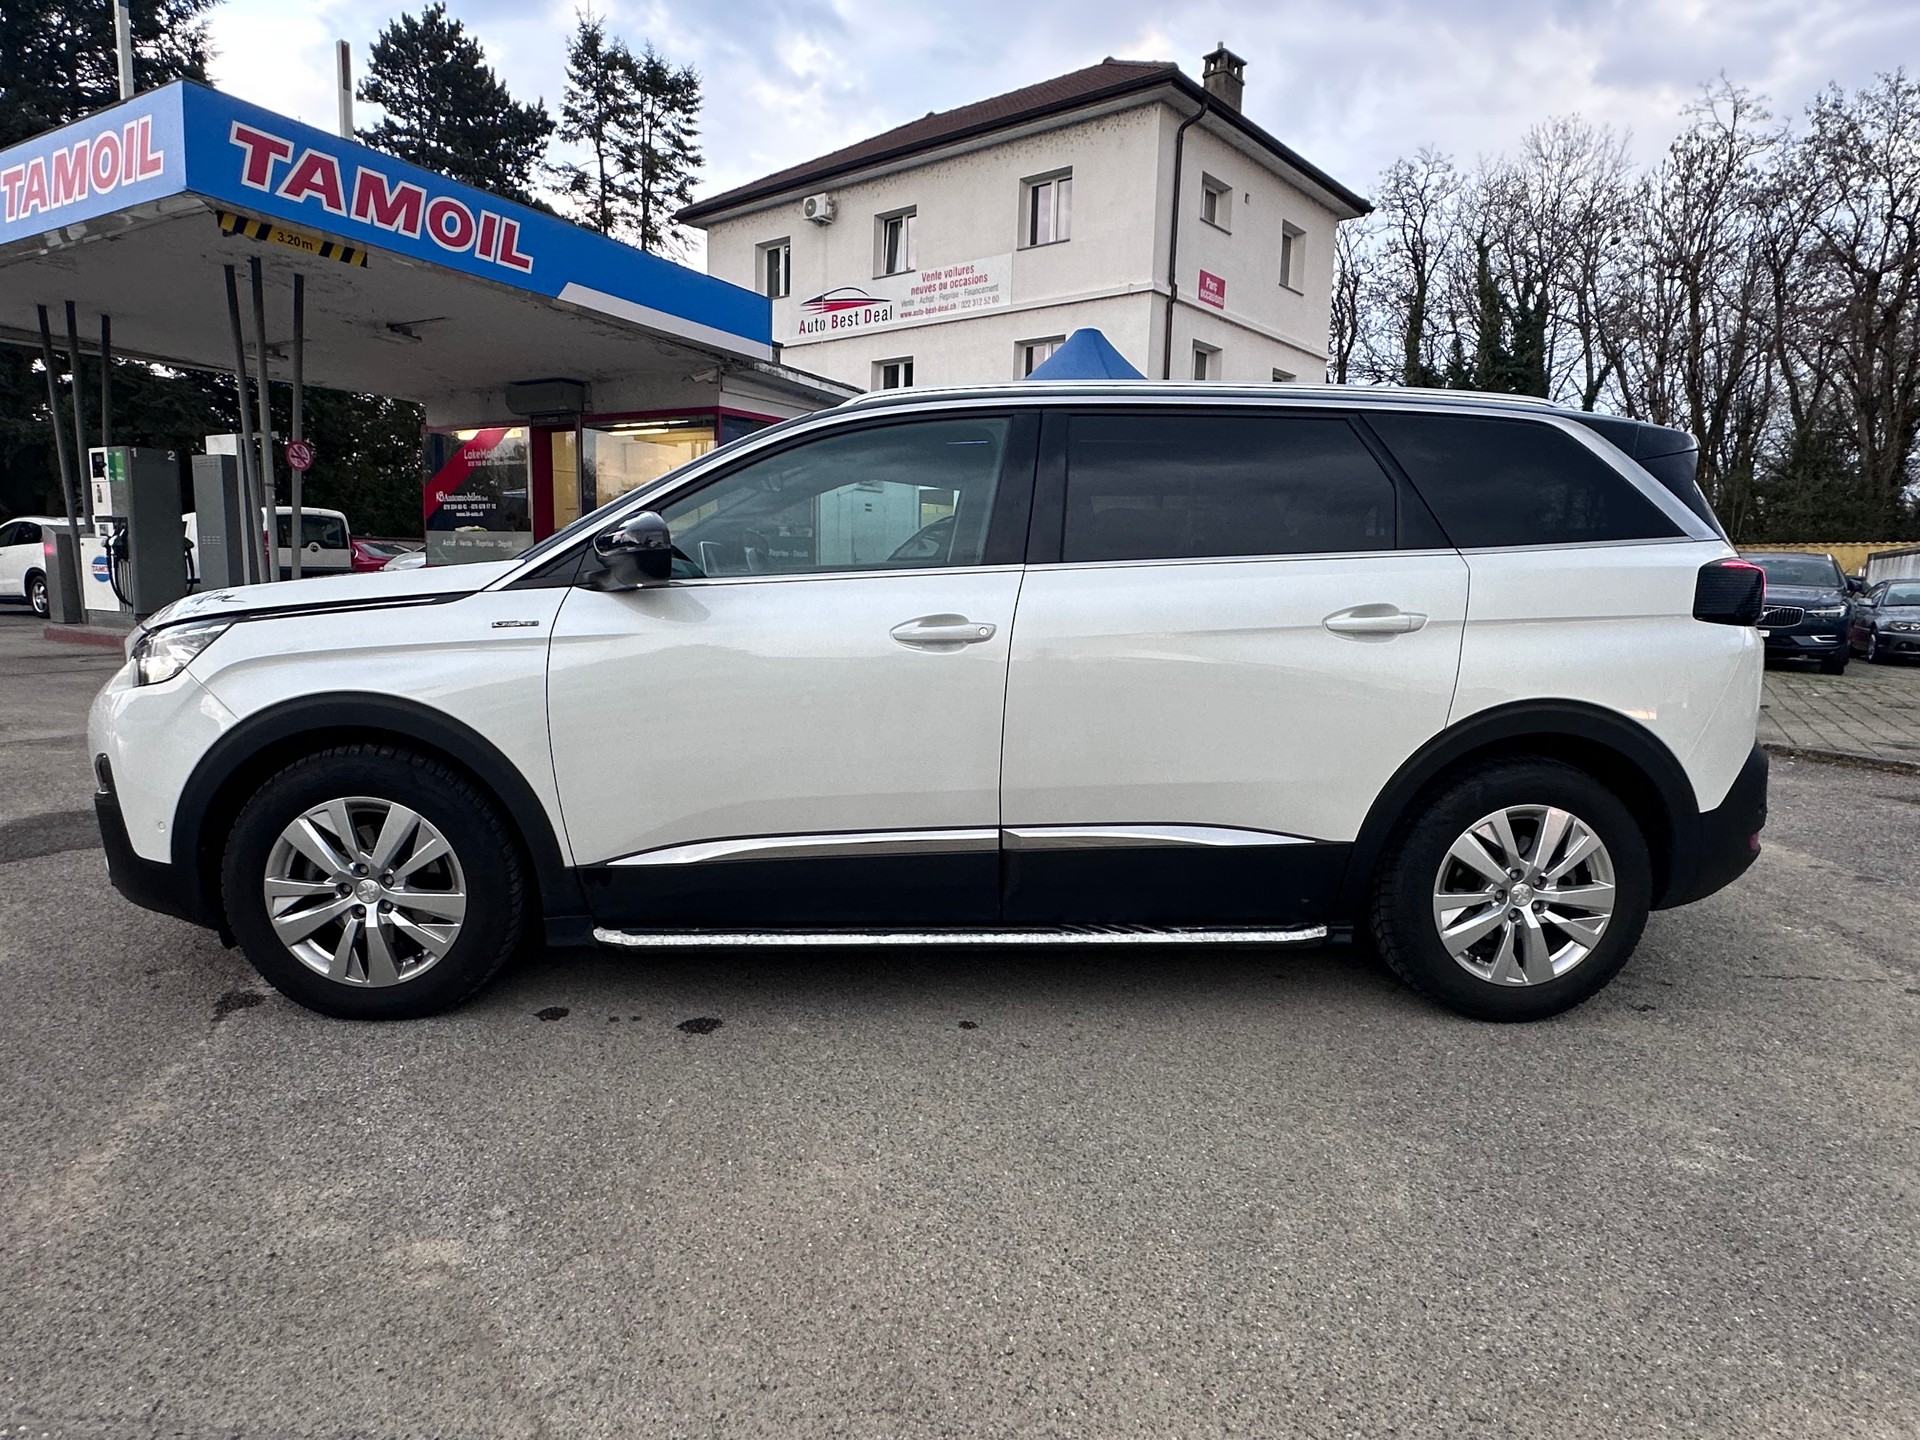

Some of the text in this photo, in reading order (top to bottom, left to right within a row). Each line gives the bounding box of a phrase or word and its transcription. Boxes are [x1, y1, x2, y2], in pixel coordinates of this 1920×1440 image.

[1, 114, 165, 223] TAMOIL
[229, 120, 534, 274] TAMOIL
[910, 273, 988, 296] neuves ou occasions
[921, 264, 975, 282] Vente voitures
[799, 305, 893, 335] Auto Best Deal
[131, 447, 138, 458] 1
[167, 450, 176, 461] 2
